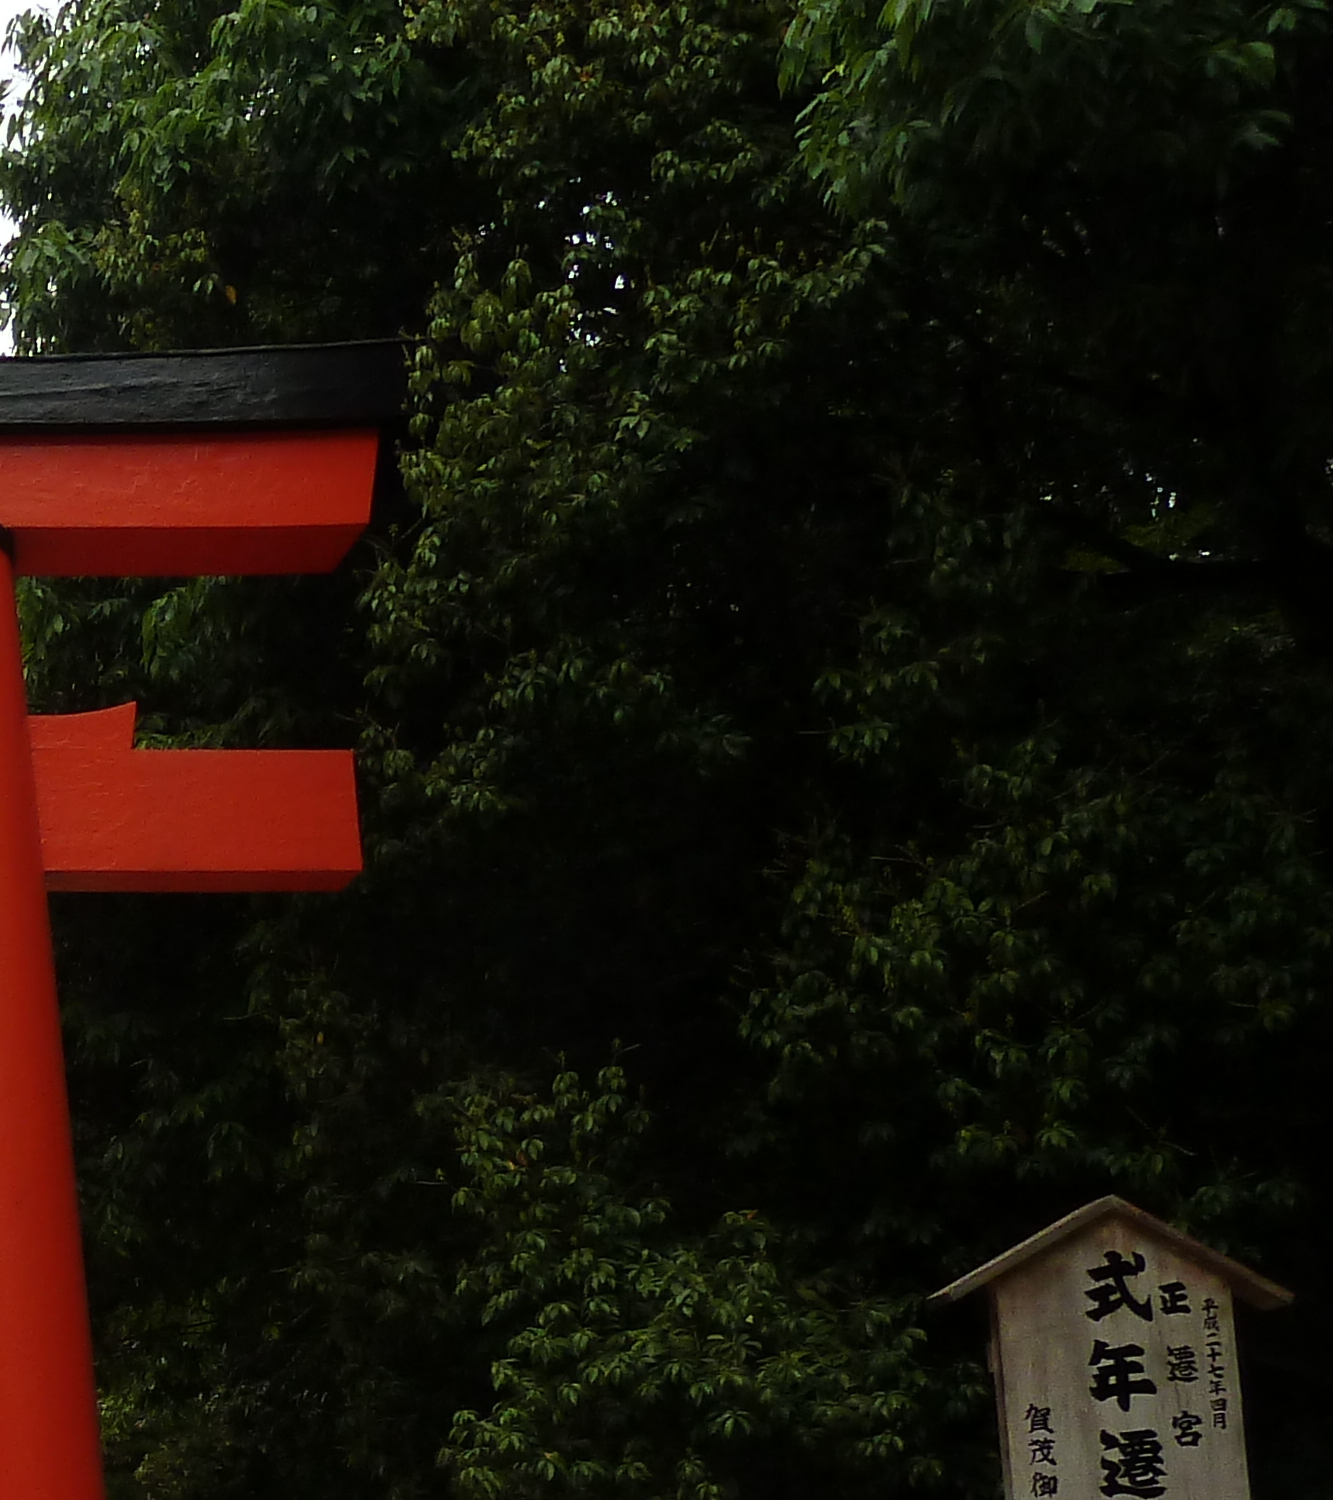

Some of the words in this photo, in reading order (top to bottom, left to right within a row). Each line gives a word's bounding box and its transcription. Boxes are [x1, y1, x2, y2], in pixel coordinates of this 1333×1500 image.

[1158, 1281, 1203, 1448] 正遷宮
[1201, 1298, 1227, 1430] 平成二十七年四月
